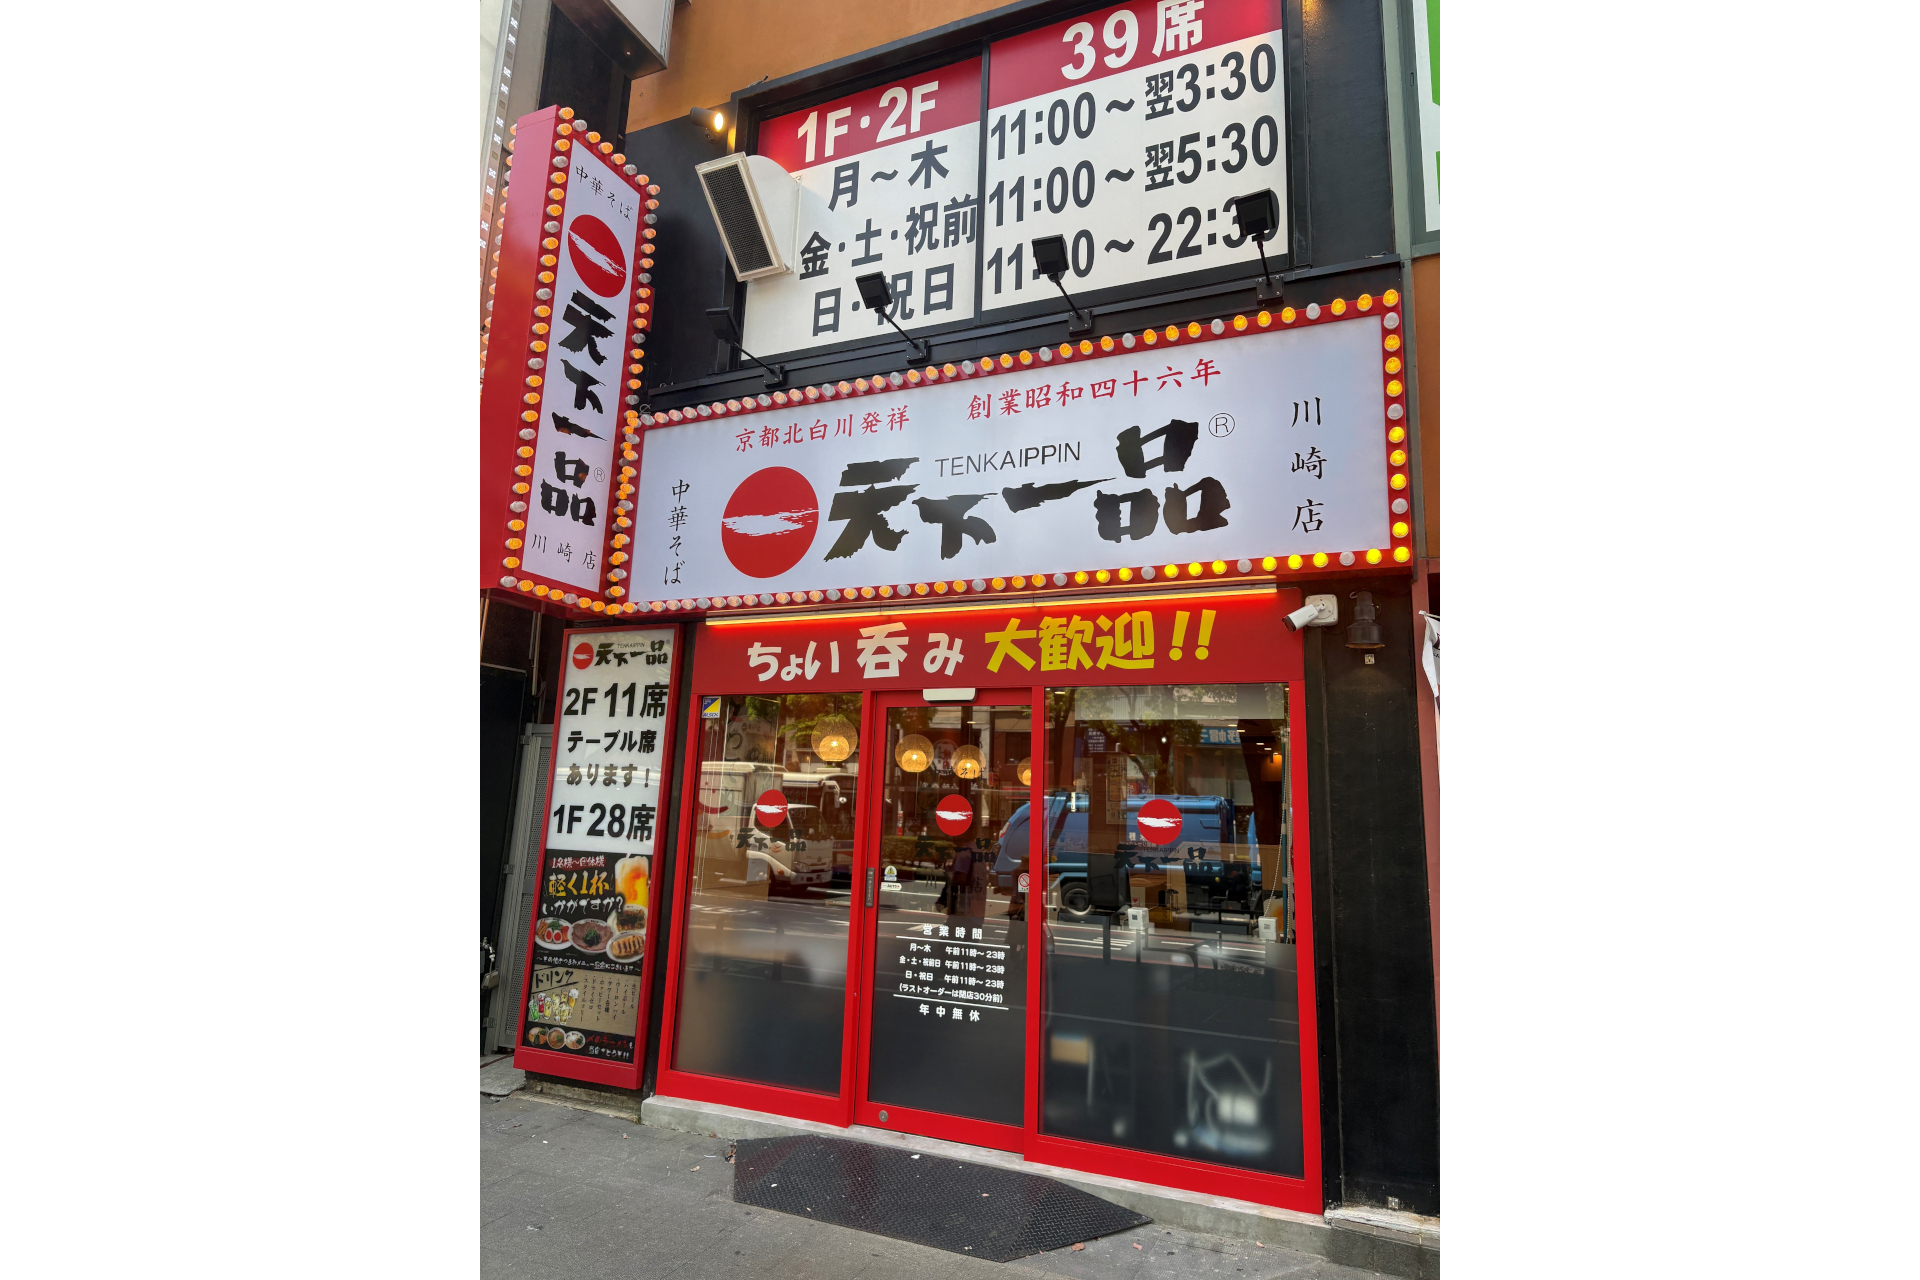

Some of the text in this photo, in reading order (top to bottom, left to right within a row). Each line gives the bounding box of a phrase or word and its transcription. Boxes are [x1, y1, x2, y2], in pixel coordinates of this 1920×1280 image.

[1061, 0, 1204, 80] 39席
[575, 165, 633, 221] 中華そば
[828, 140, 949, 212] 月～木
[540, 289, 617, 526] 天下一品
[735, 358, 1221, 452] 京都北白川発祥 創業昭和四十六年
[935, 441, 1081, 478] TENKAIPPIN
[1291, 396, 1327, 534] 川崎店
[824, 419, 1231, 562] 天下一品
[664, 479, 690, 585] 中華そば
[531, 534, 597, 570] 川崎店
[594, 639, 669, 668] 天下一品
[564, 687, 598, 716] 2F
[567, 730, 657, 754] テーブル席
[553, 804, 584, 834] 1F
[549, 870, 610, 898] 軽く1杯
[909, 943, 931, 953] 月～木
[923, 923, 983, 940] 営業時間
[535, 970, 574, 988] ドリンク
[919, 1003, 980, 1022] 年中無休
